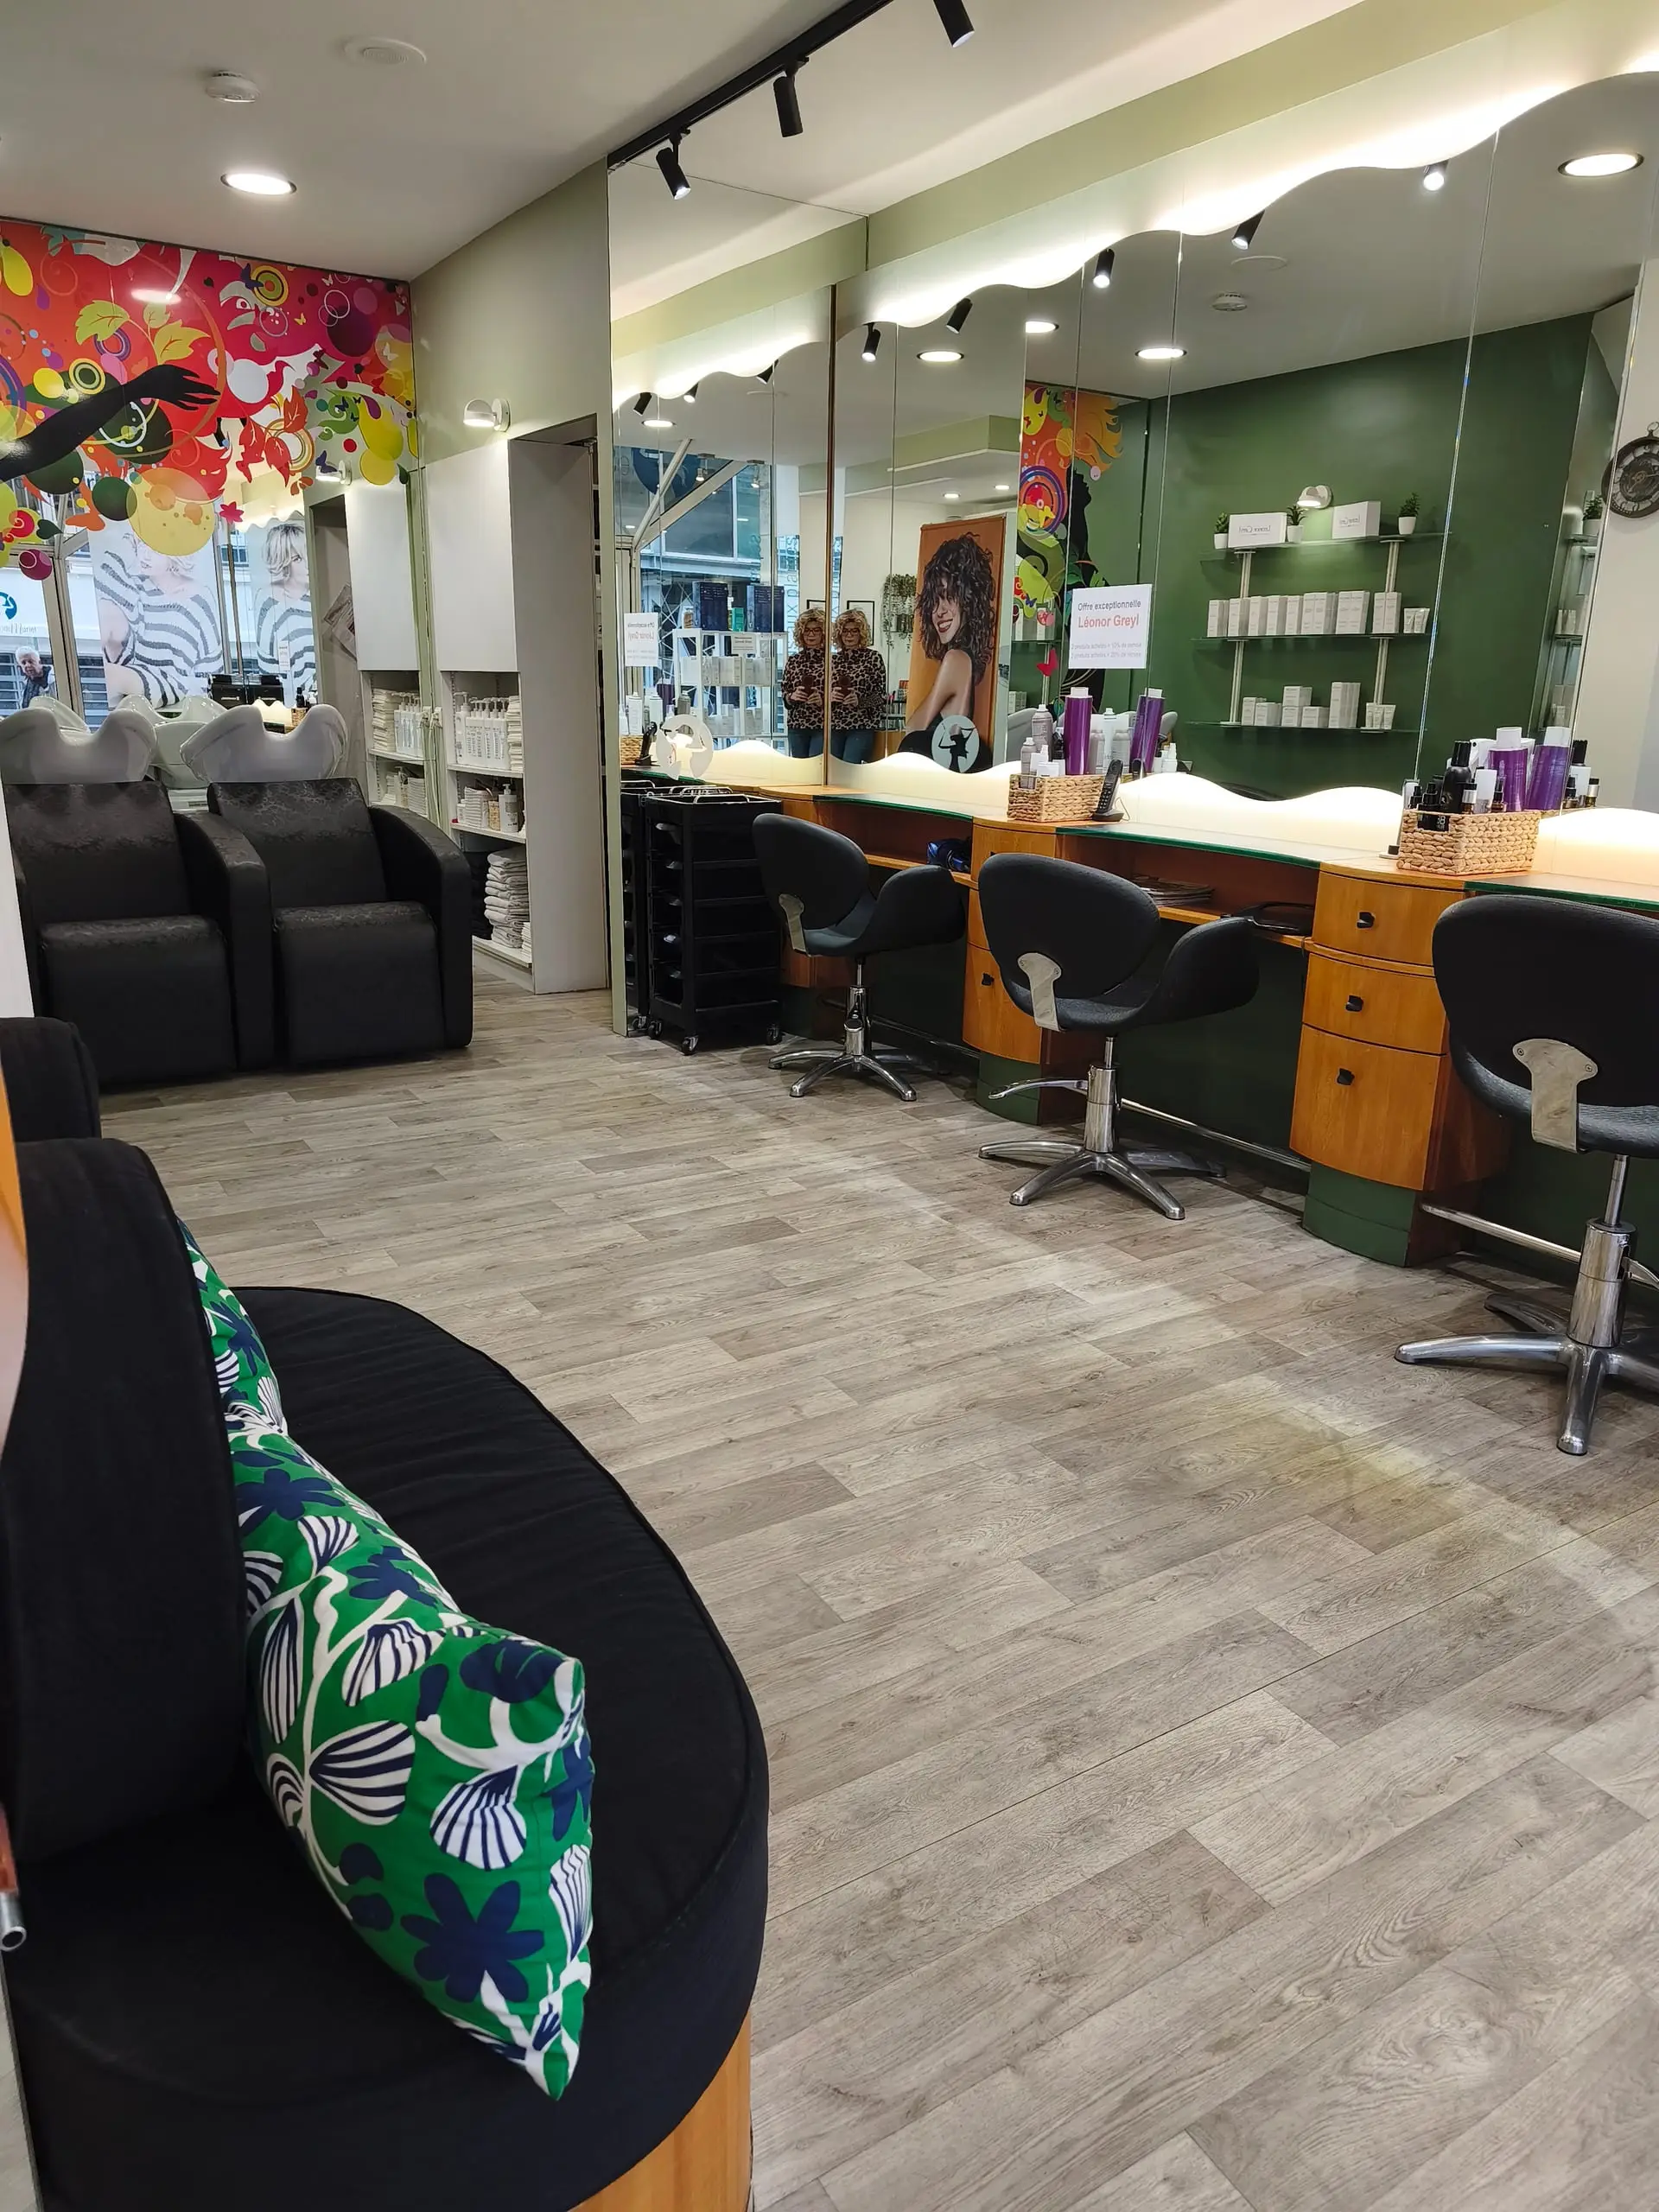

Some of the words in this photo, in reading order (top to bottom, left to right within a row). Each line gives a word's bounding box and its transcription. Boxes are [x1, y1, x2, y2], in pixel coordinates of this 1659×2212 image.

[1094, 600, 1141, 611] exceptionnelle
[1078, 615, 1111, 628] Léonor
[1113, 613, 1139, 629] Greyl
